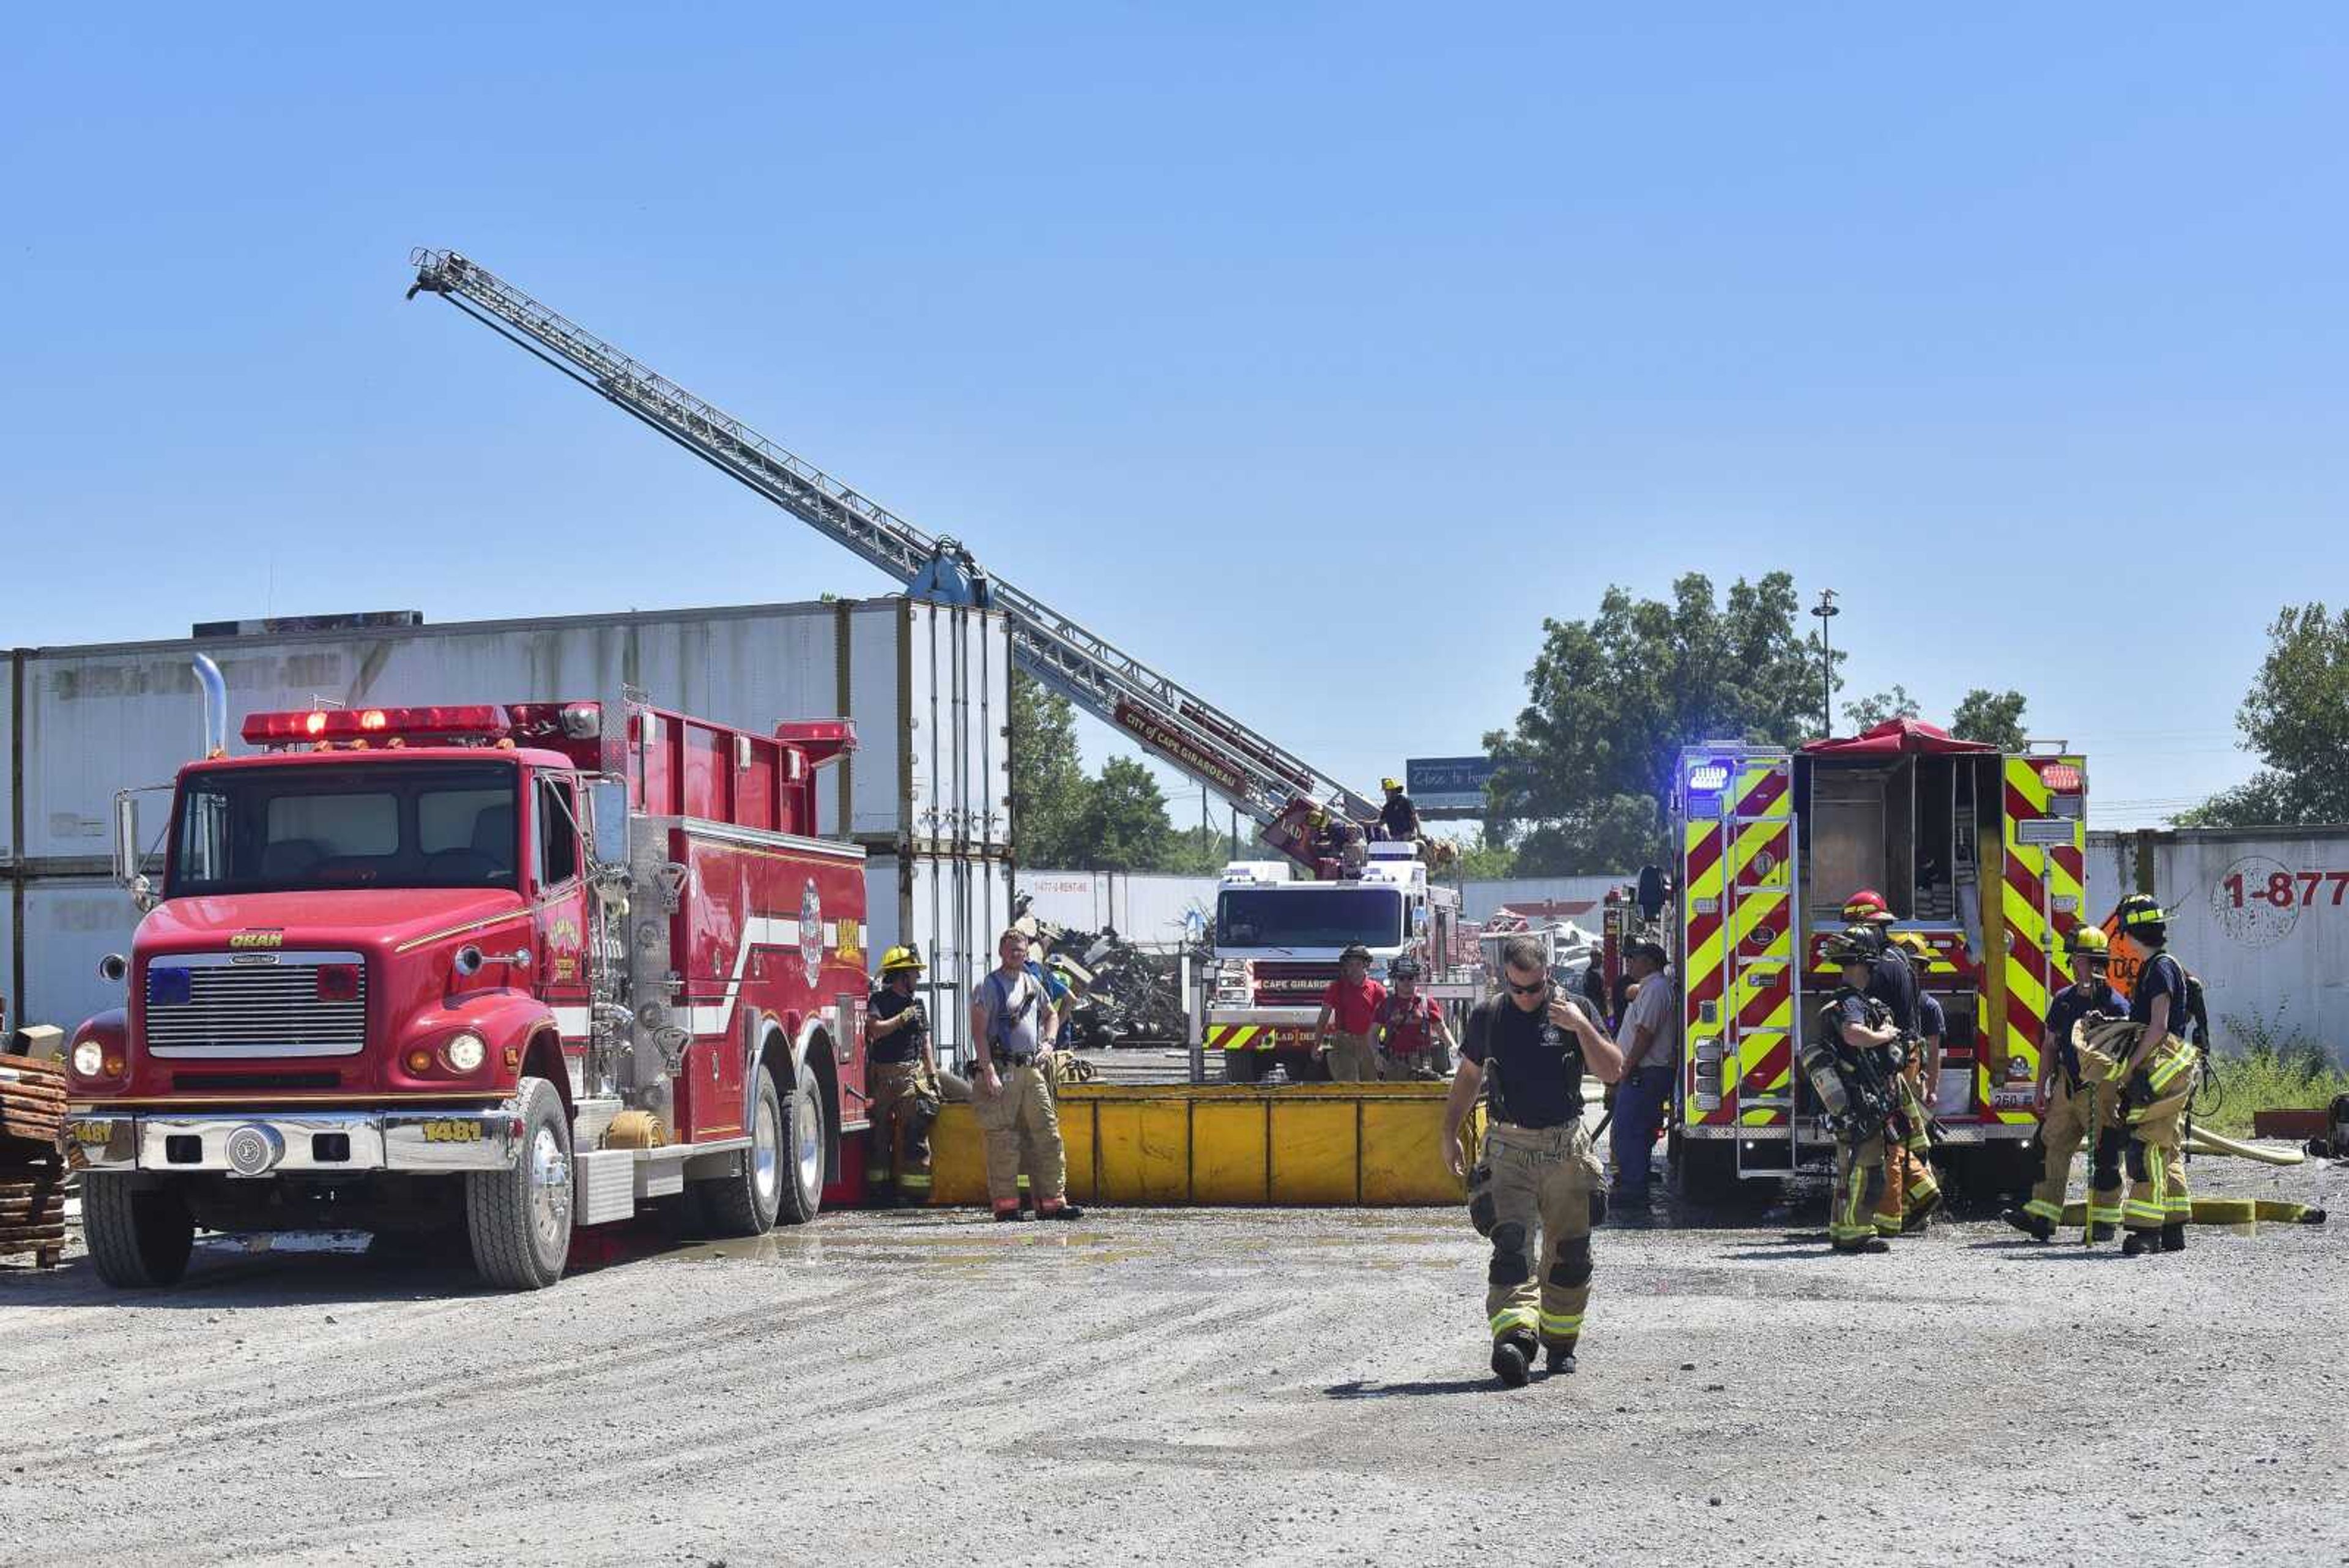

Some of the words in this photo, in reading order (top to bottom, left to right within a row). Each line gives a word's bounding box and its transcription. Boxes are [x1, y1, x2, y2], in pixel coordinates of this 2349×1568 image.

[1127, 713, 1146, 730] CITY
[1146, 726, 1157, 739] of
[1158, 734, 1181, 753] CAPE
[1181, 747, 1236, 786] GIRARDEAU
[229, 934, 283, 947] ORAN
[1263, 979, 1288, 989] CAPE
[423, 1121, 481, 1142] 1481
